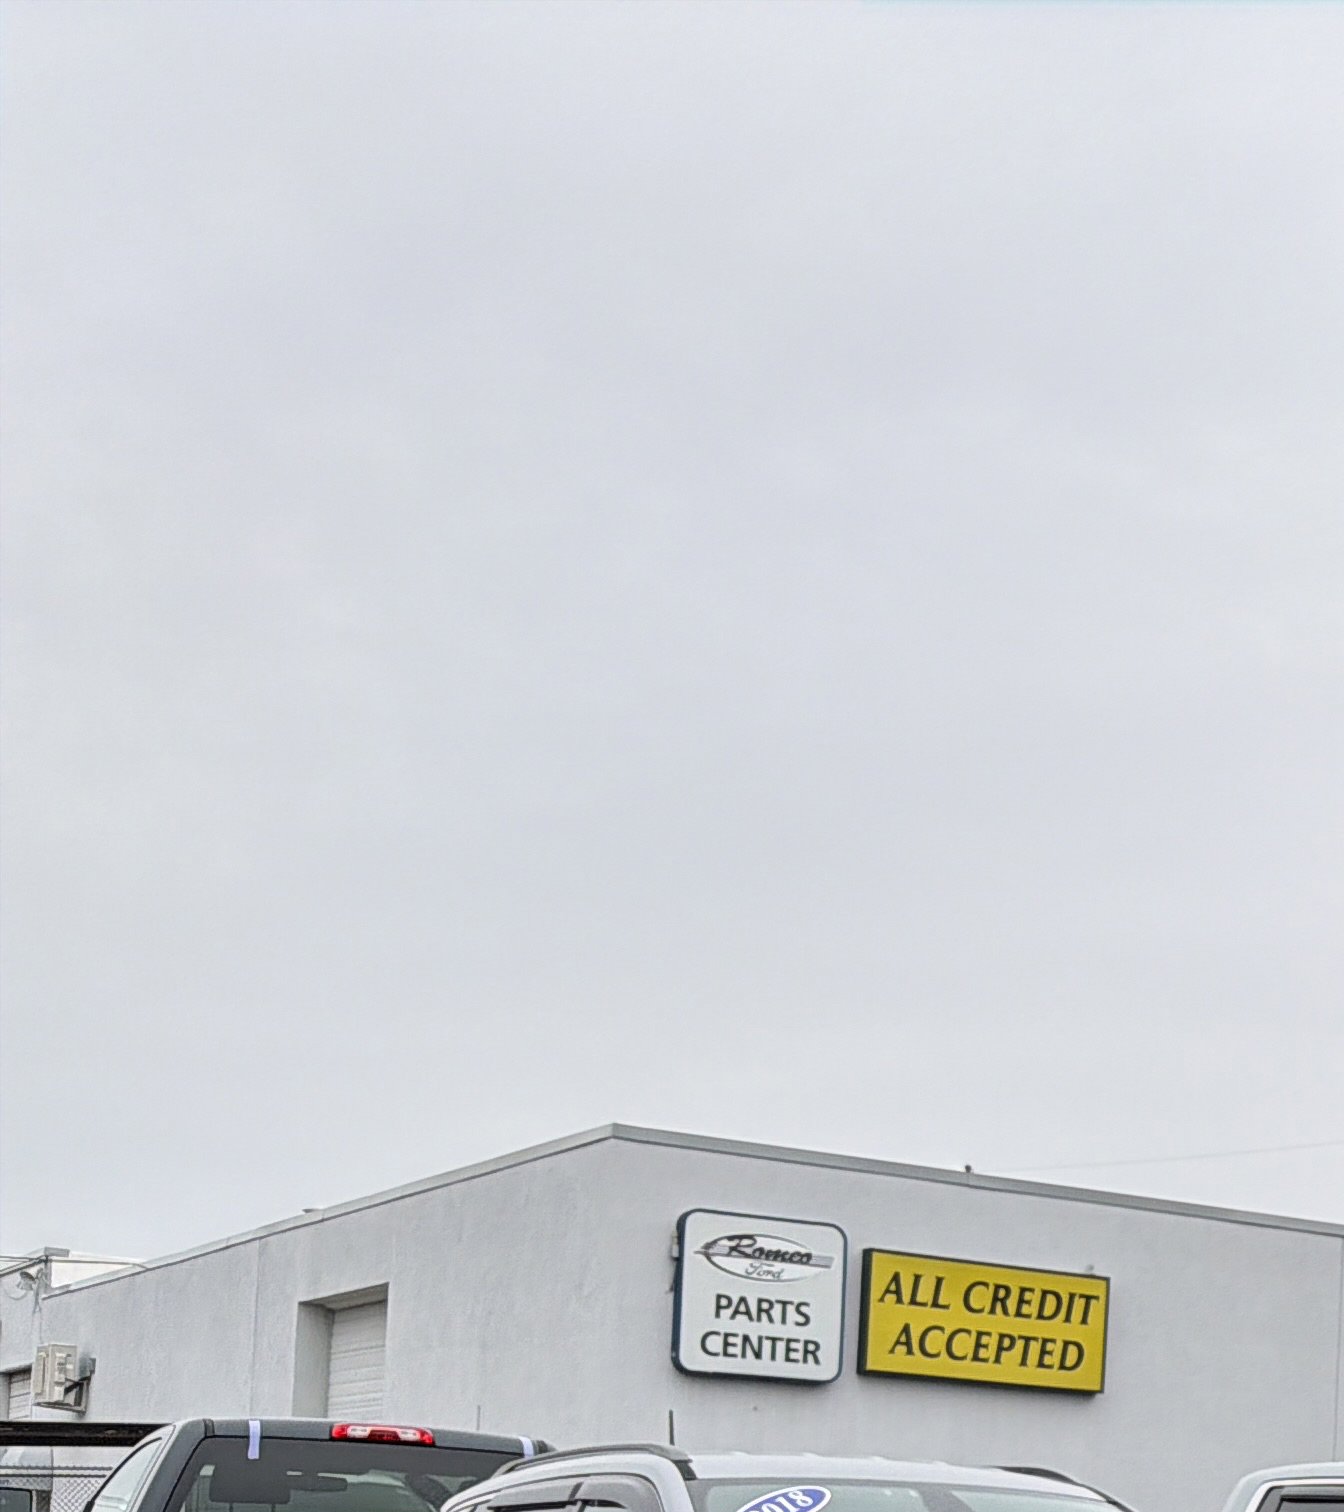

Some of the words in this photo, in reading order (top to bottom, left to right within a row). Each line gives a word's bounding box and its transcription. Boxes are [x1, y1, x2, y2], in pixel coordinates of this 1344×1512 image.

[726, 1233, 813, 1264] Romeo
[745, 1261, 784, 1279] Ford
[714, 1292, 811, 1327] PARTS
[878, 1271, 951, 1312] ALL
[963, 1280, 1100, 1327] CREDIT
[700, 1330, 821, 1366] CENTER
[888, 1322, 1086, 1373] ACCEPTED
